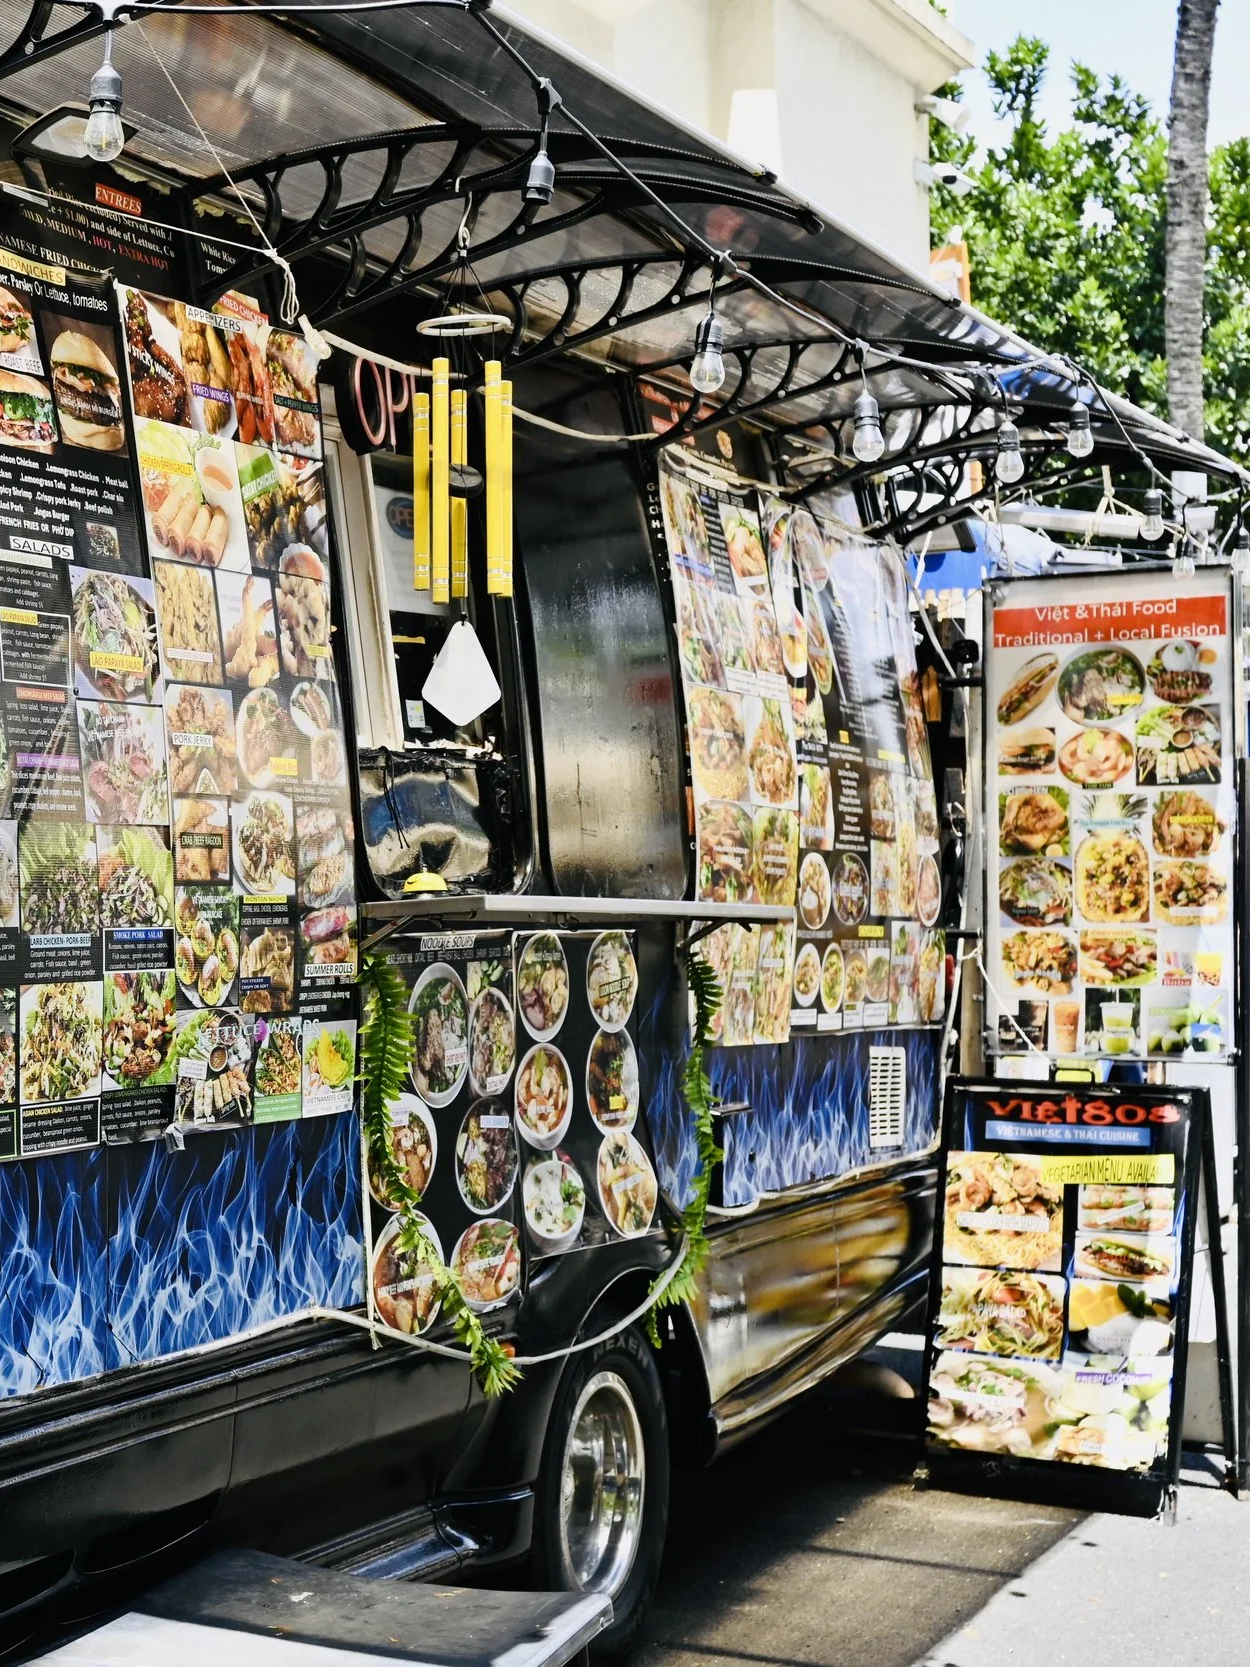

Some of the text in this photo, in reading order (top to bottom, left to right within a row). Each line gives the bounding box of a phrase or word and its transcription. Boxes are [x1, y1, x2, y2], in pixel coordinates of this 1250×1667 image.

[95, 187, 142, 213] ENTREES
[219, 296, 238, 313] FRIED
[3, 355, 41, 373] ROAST BEEF
[193, 384, 230, 402] FRIED WINGS
[0, 515, 22, 528] FRENCH
[23, 519, 39, 531] FRIES
[41, 522, 49, 531] OR
[65, 527, 74, 537] DIP
[12, 538, 71, 558] SALADS
[1035, 605, 1070, 623] Việt
[1133, 599, 1177, 615] Food
[996, 629, 1088, 647] Traditional
[1111, 624, 1154, 641] Local
[1161, 623, 1220, 637] Fusion
[174, 734, 211, 745] PORK JERKY
[30, 937, 41, 947] LARB
[113, 931, 163, 939] SMOKE PORK SALAD
[422, 936, 474, 949] NOODLE SOUPS
[307, 964, 353, 975] SUMMER ROLLS
[267, 1018, 320, 1037] WRAPS
[996, 1125, 1061, 1138] VIETNAMESE
[1064, 1130, 1071, 1138] &
[1100, 1131, 1139, 1142] CUISINE
[1043, 1162, 1095, 1182] VEGETARIAN
[1097, 1161, 1123, 1181] MENU
